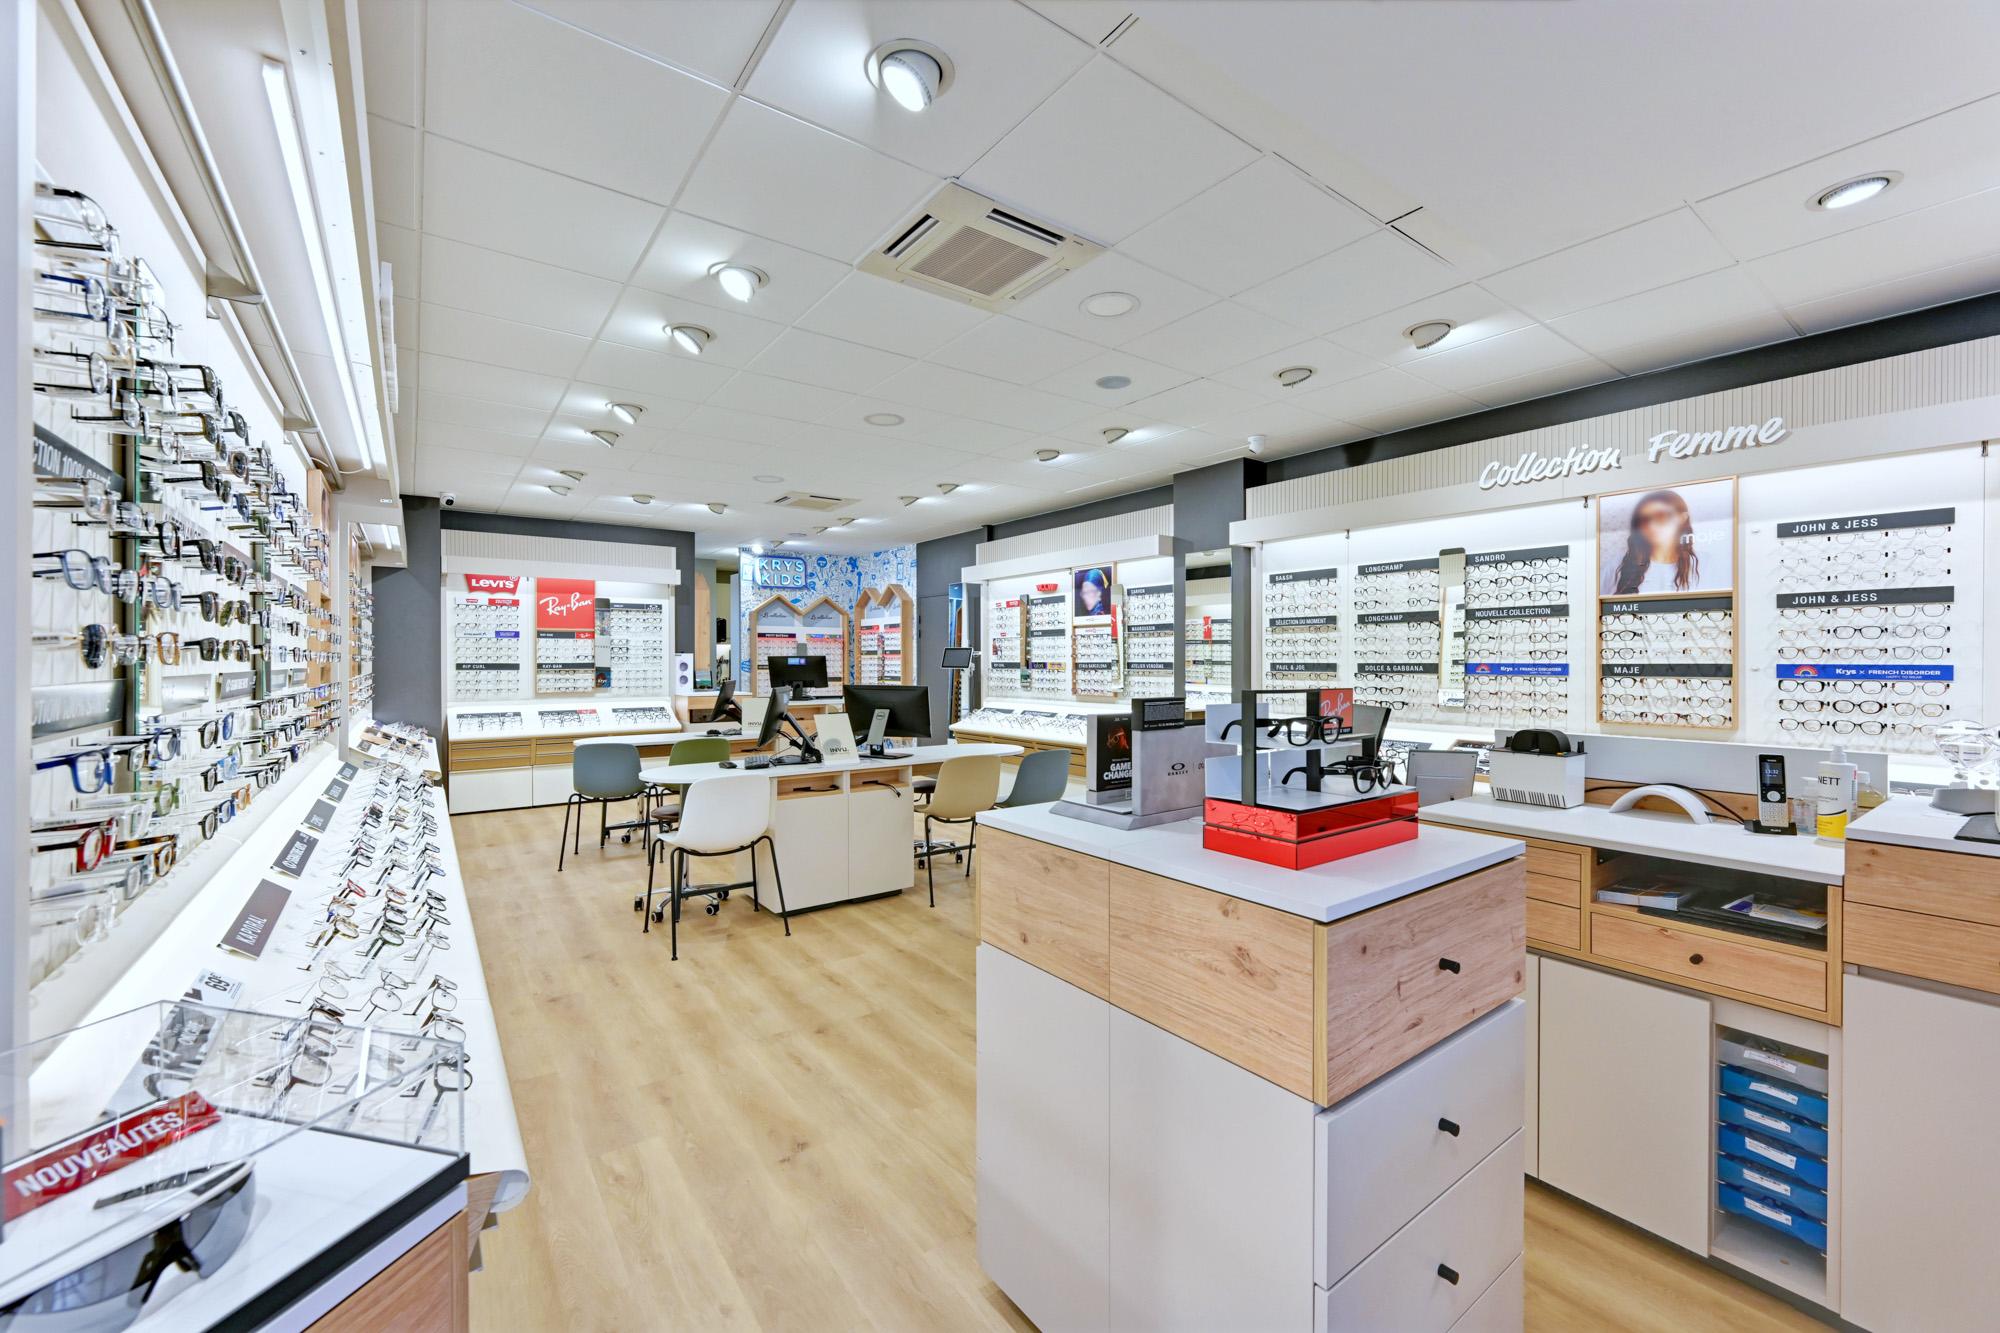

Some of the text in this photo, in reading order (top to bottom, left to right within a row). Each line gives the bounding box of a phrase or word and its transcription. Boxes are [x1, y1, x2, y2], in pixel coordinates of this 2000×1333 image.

[1479, 417, 1786, 489] Collection Femme
[1793, 518, 1879, 534] JOHN & JESS
[1474, 553, 1506, 563] SANDRO
[758, 558, 804, 572] KRYS
[1365, 563, 1404, 573] LONGCHAMP
[760, 573, 802, 586] KIDS
[1793, 592, 1878, 606] JOHN & JESS
[1613, 603, 1640, 612] MAJE
[1475, 608, 1551, 618] NOUVELLE COLLECTION
[1365, 614, 1404, 623] LONGCHAMP
[1365, 664, 1424, 672] DOLCE & GABBANA
[1613, 666, 1640, 674] MAJE
[1835, 668, 1857, 676] Krys
[1110, 762, 1132, 772] GAME
[1817, 775, 1841, 786] NETT
[13, 1111, 184, 1198] NOUVEAUTÉS
